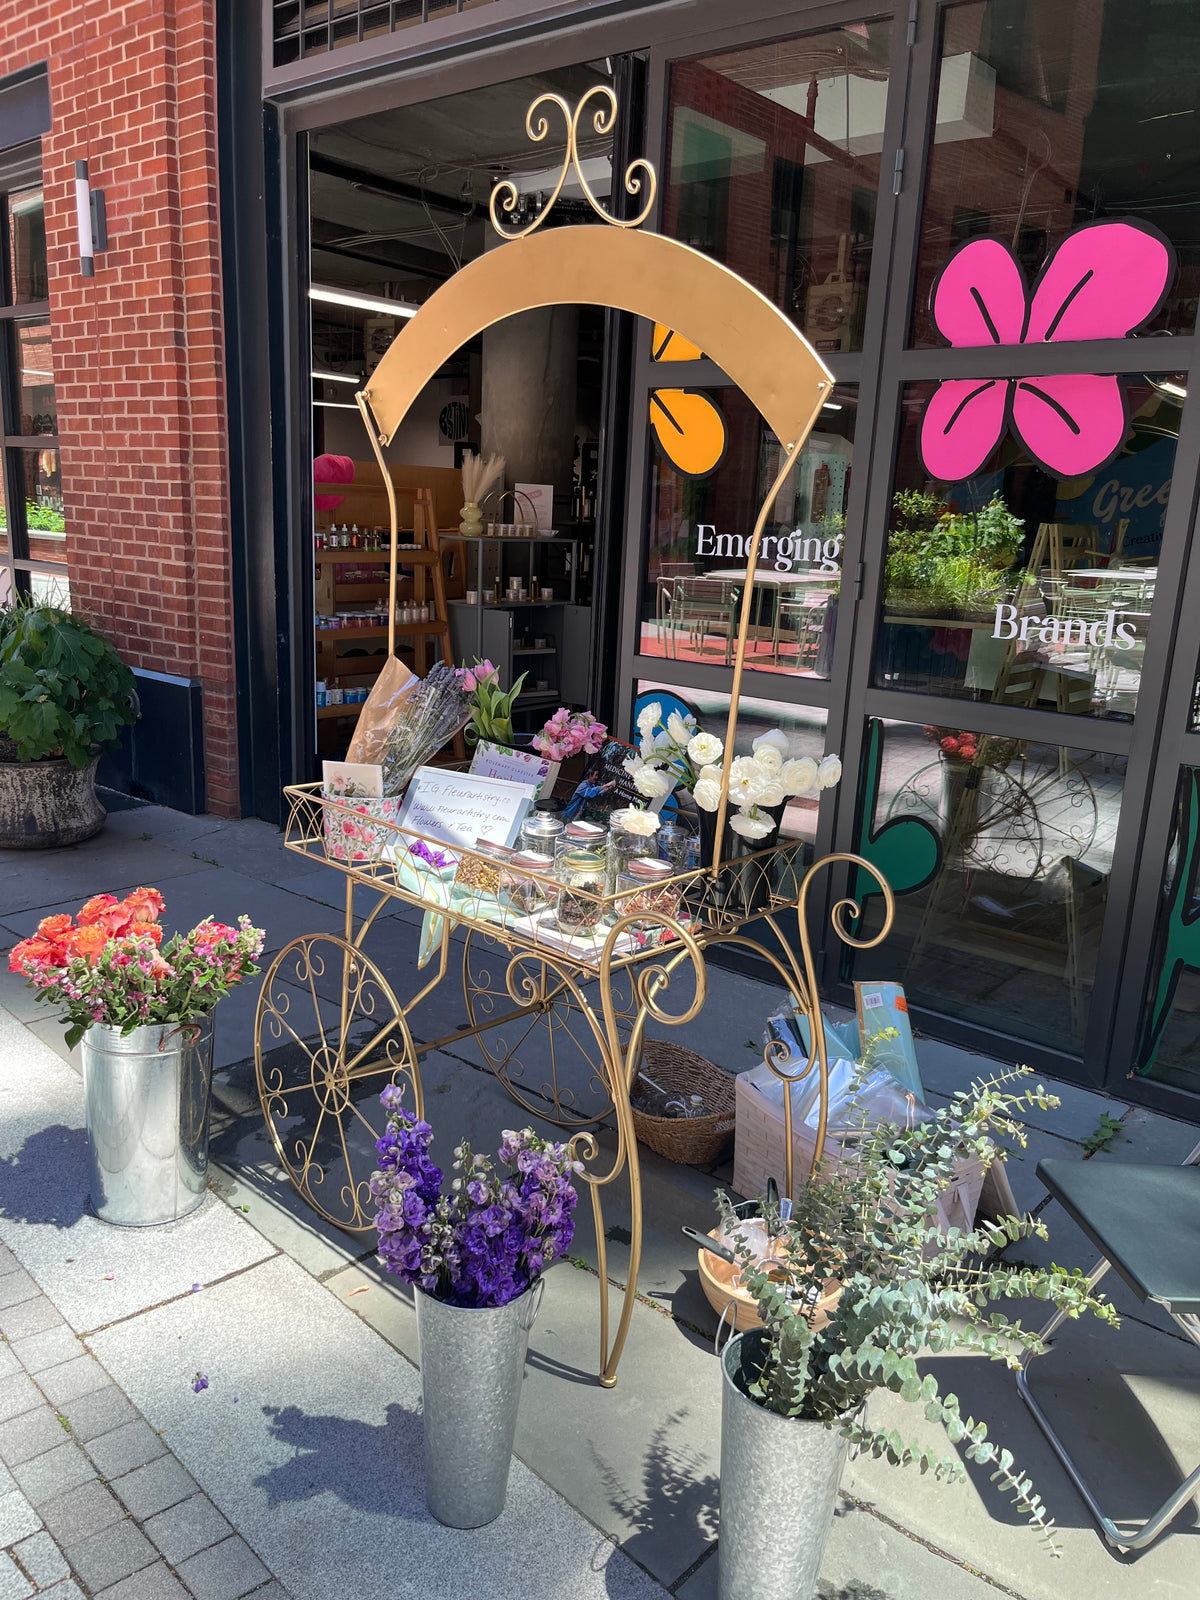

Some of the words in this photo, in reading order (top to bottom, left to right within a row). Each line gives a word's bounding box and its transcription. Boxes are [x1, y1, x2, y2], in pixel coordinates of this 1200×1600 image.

[695, 524, 845, 575] Emerging
[991, 603, 1137, 650] Brands
[411, 815, 442, 829] Flowers
[456, 822, 473, 833] Tea
